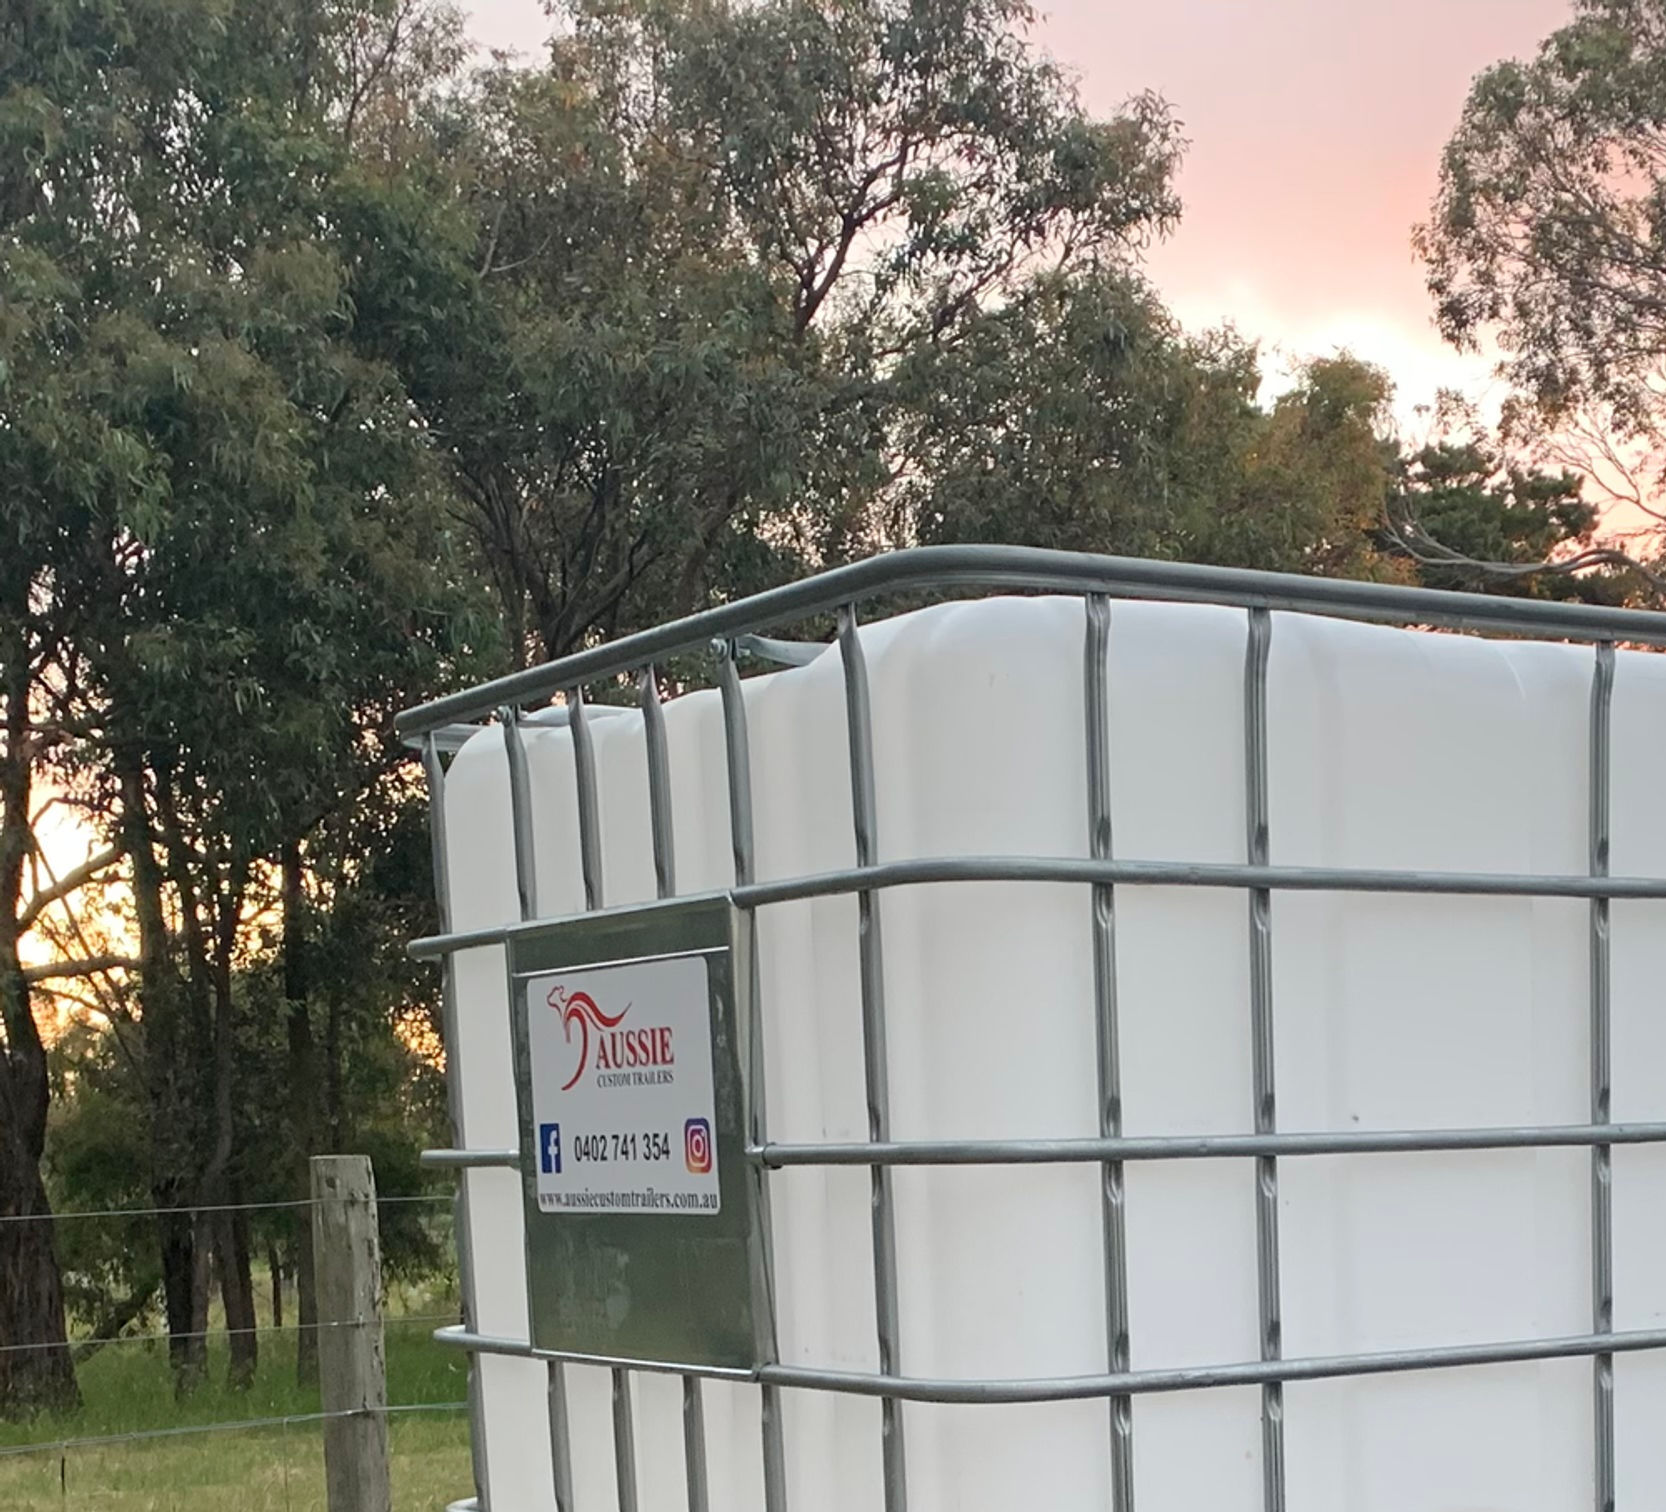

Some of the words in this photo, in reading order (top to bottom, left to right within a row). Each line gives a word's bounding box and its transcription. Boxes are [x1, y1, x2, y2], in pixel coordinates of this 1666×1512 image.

[596, 1027, 674, 1070] AUSSIE
[597, 1073, 631, 1088] CUSTOM
[632, 1070, 674, 1085] TRAILERS
[574, 1135, 608, 1162] 0402
[611, 1133, 637, 1161] 741
[643, 1132, 670, 1161] 354
[540, 1187, 718, 1209] www.aussiecustomtrailers.com.au
